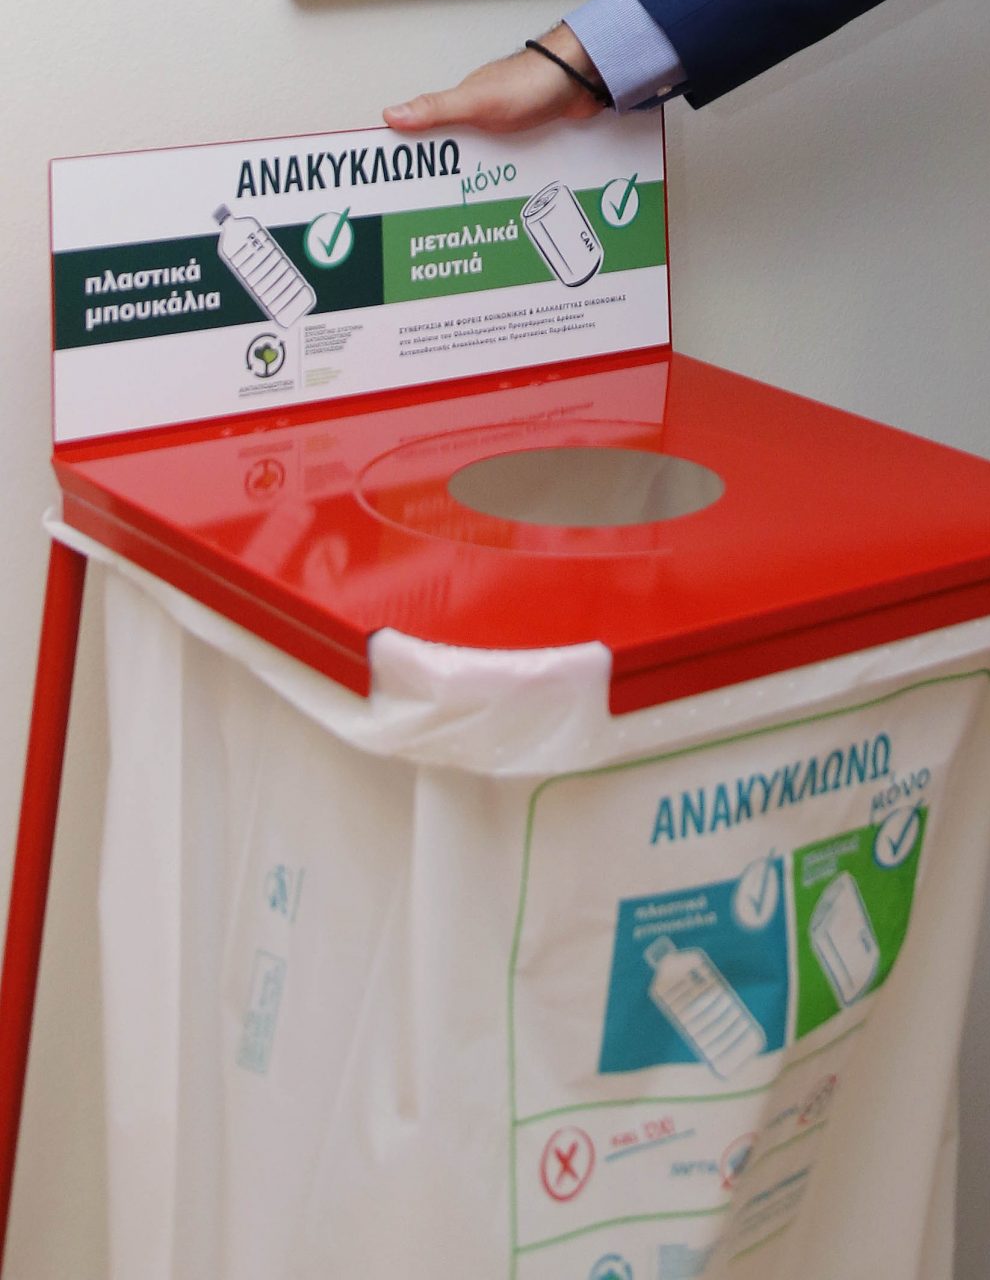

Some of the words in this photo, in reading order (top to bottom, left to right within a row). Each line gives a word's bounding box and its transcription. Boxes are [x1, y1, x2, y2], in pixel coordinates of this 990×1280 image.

[236, 139, 461, 198] ΑΝΑΚΥΚΛΩΝΩ
[461, 161, 517, 208] μόνο
[247, 232, 264, 251] PET
[410, 219, 518, 257] μεταλλικά
[580, 231, 595, 252] CAN
[85, 258, 200, 294] πλαστικά
[411, 251, 482, 281] κουτιά
[86, 290, 220, 331] μπουκάλια
[456, 316, 482, 326] ΦΟΡΕΙΣ
[585, 294, 626, 307] ΟΙΚΟΝΟΜΙΑΣ
[650, 730, 891, 845] ΑΝΑΚΥΚΛΩΝΩ
